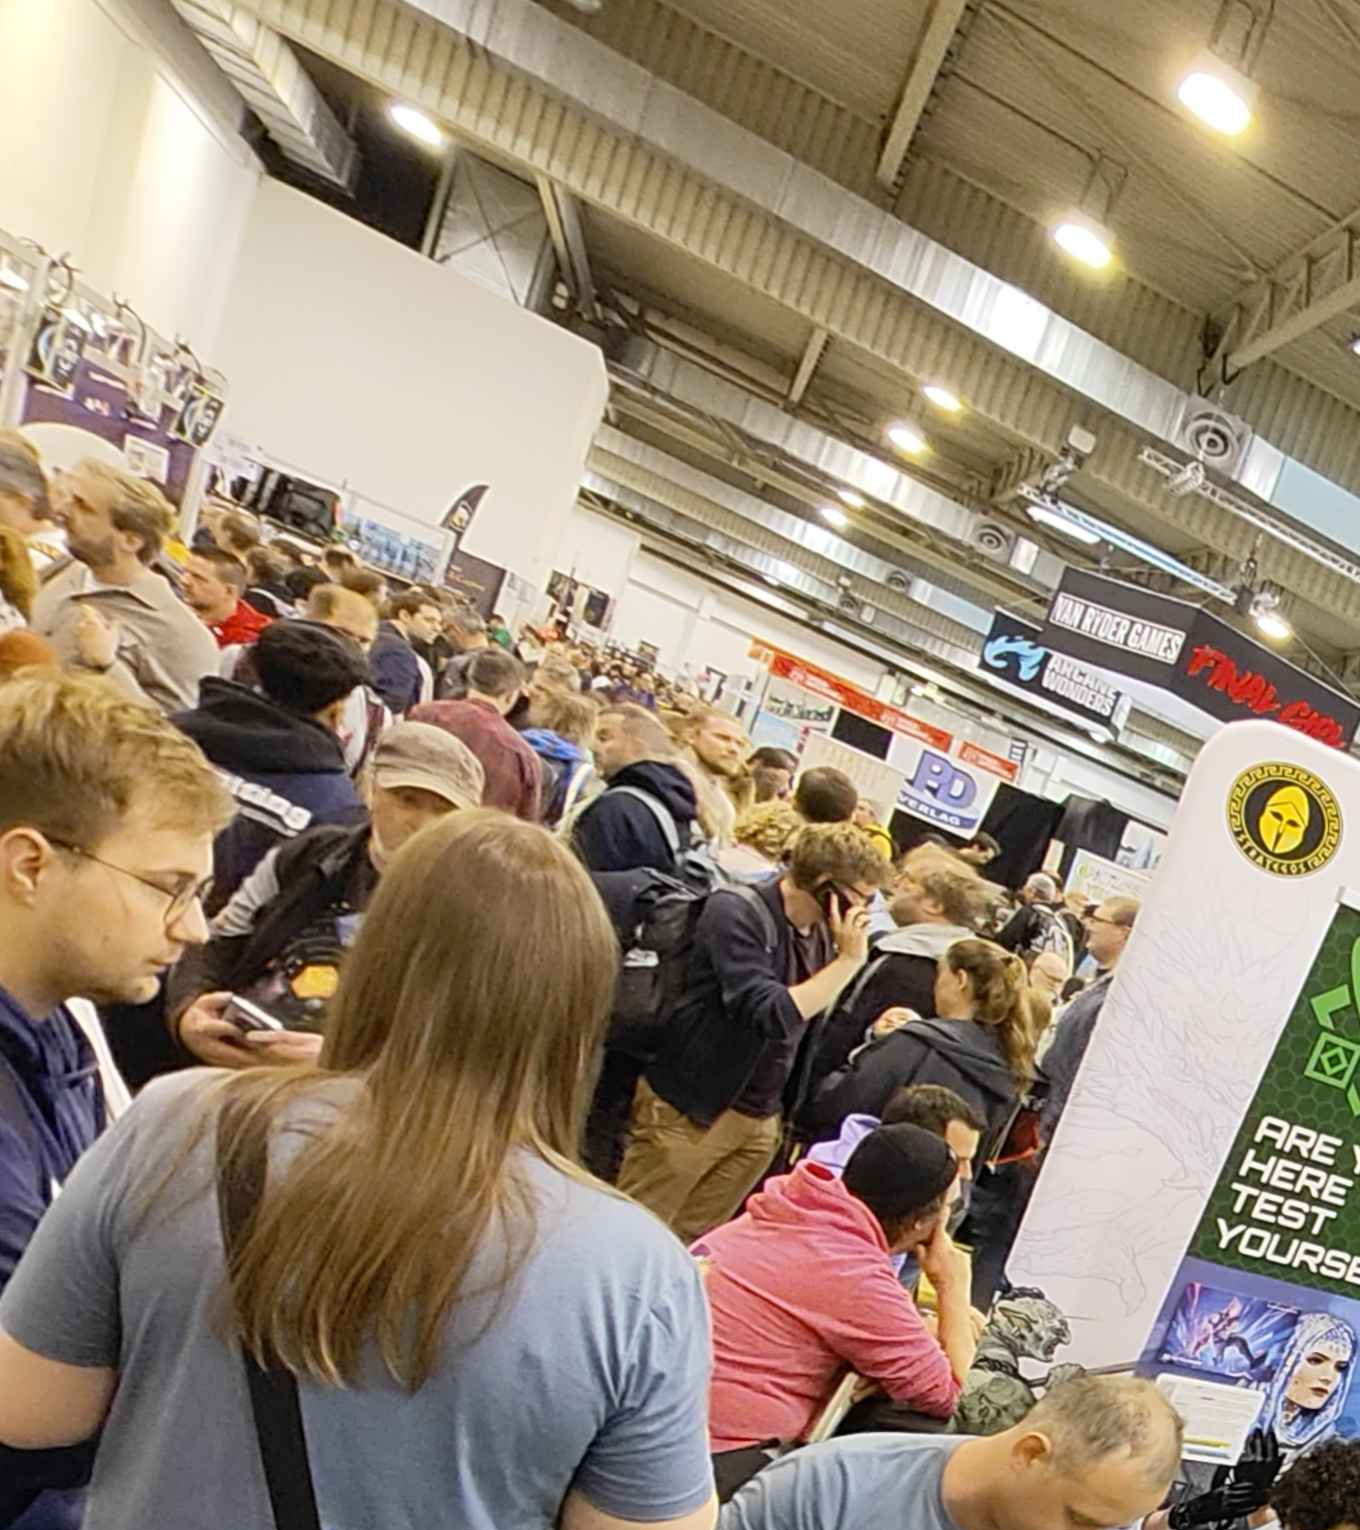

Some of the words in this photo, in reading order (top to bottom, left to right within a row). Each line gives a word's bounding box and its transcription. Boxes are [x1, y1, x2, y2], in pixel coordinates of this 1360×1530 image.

[1053, 595, 1087, 628] VAN
[1086, 607, 1128, 645] RYDER
[1127, 622, 1184, 662] GAMES
[1041, 669, 1115, 718] WONDERS
[1046, 653, 1121, 700] ARCANE
[1186, 643, 1280, 714] FINAL
[899, 791, 961, 827] VERLAG
[1254, 1116, 1343, 1167] ARE
[1239, 1150, 1351, 1206] HERE
[1230, 1182, 1337, 1236] TEST
